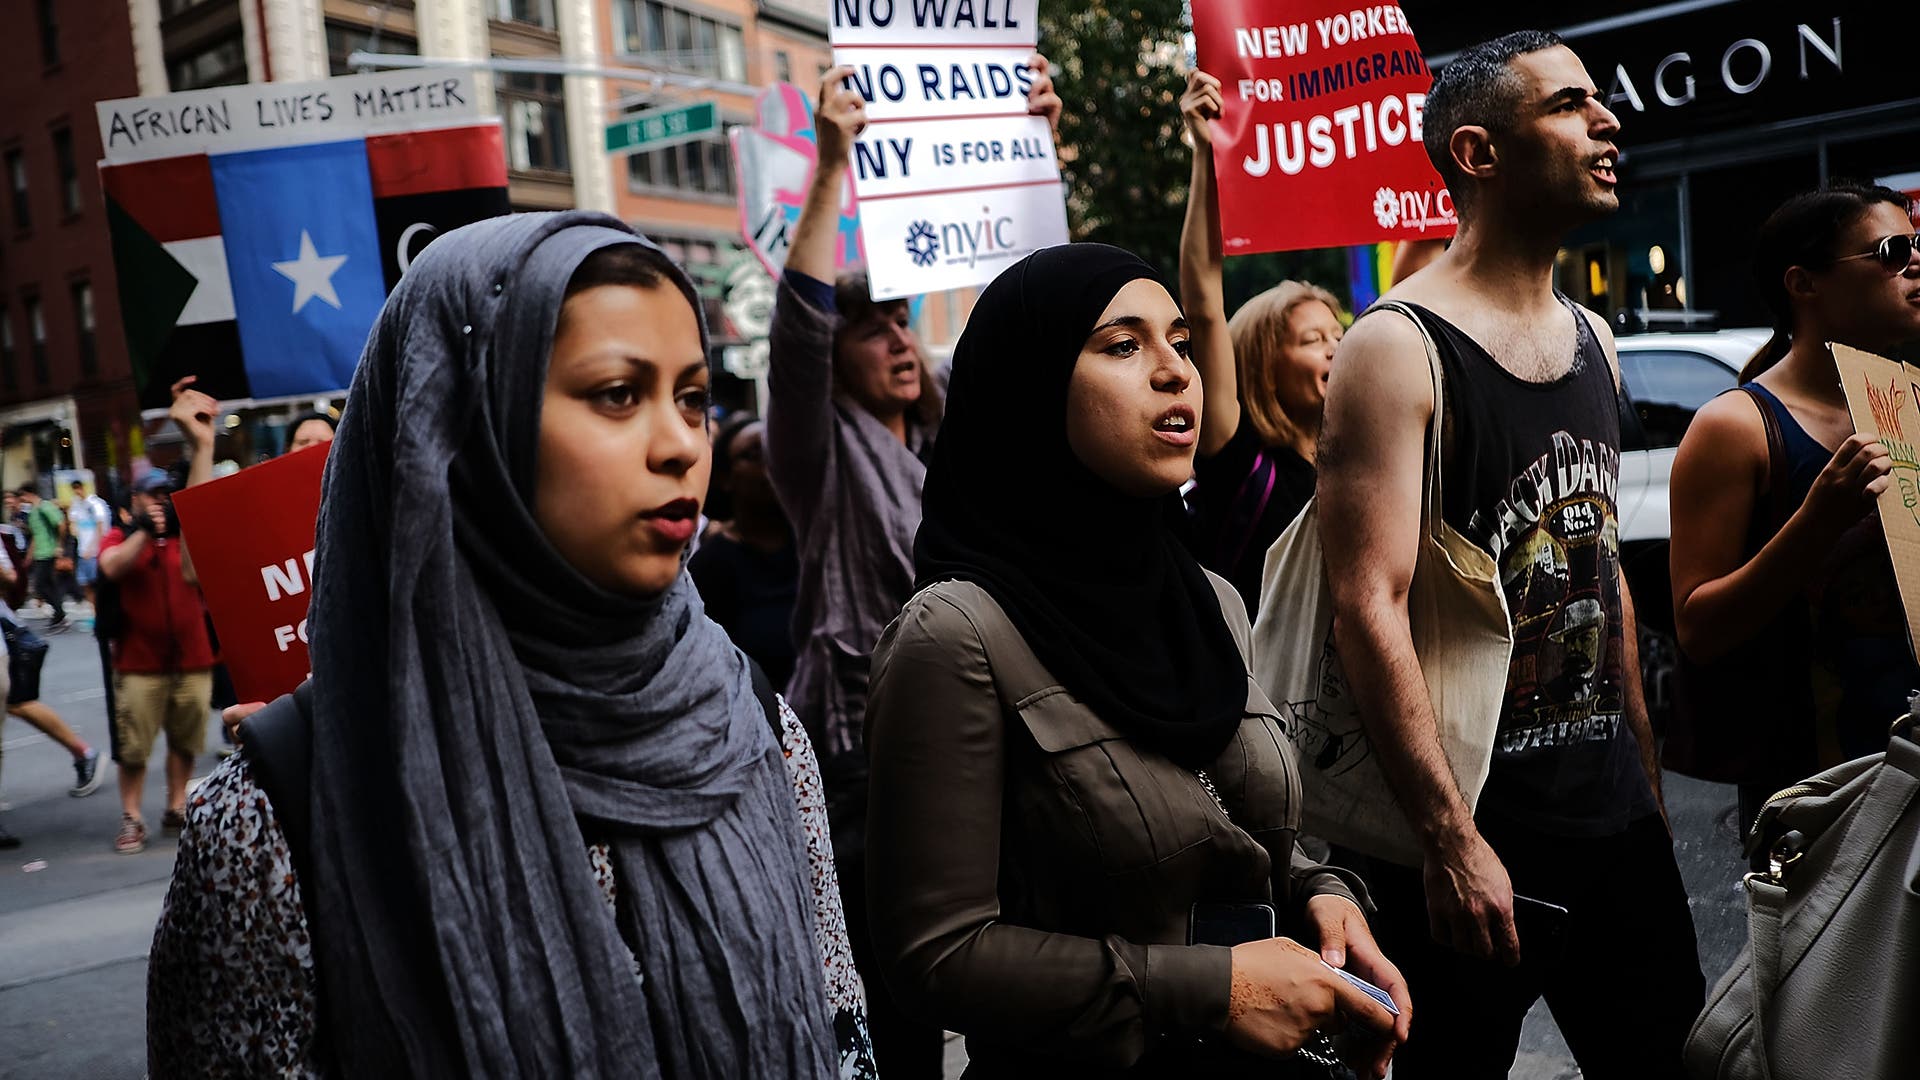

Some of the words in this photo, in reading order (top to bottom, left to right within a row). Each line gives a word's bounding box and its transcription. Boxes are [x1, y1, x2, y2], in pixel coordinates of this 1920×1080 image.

[835, 0, 894, 27] NO
[913, 0, 1019, 28] WALL
[1235, 23, 1308, 59] NEW
[1316, 5, 1414, 49] YORKER
[842, 64, 906, 103] NO
[917, 63, 1033, 100] RAIDS
[1238, 79, 1283, 102] FOR
[108, 99, 231, 148] AFRICAN
[257, 93, 334, 127] LIVES
[353, 79, 467, 118] MATTER
[1243, 93, 1426, 177] JUSTICE
[853, 137, 913, 180] NY
[933, 143, 955, 166] IS
[961, 141, 1004, 164] FOR
[1011, 137, 1046, 160] ALL
[1400, 180, 1455, 233] nyic
[941, 206, 1016, 269] nyic
[1563, 502, 1592, 519] Old
